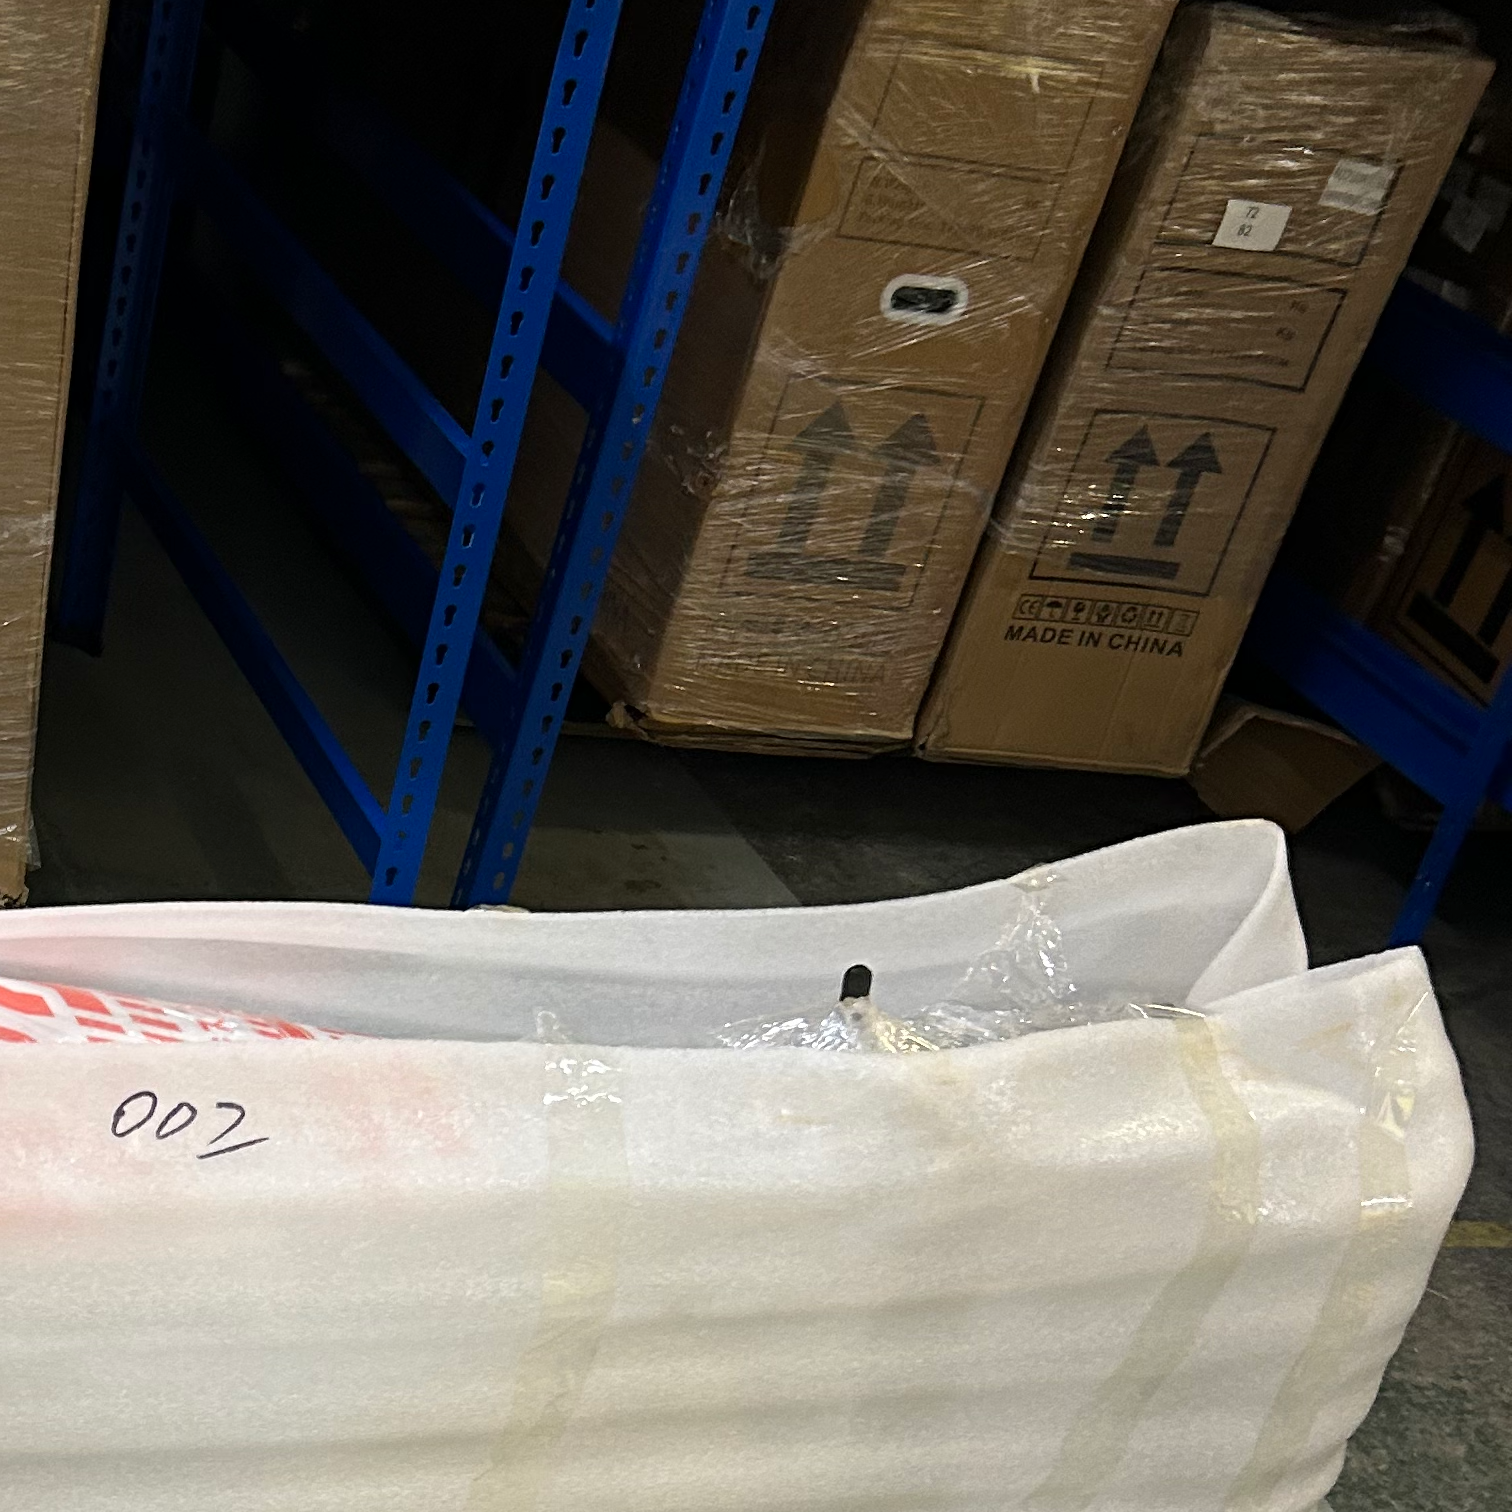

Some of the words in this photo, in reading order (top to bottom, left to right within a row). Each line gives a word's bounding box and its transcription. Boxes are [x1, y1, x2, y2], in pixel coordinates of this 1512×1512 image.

[1245, 206, 1260, 219] 72
[1004, 625, 1074, 645] MADE
[1077, 630, 1102, 648] IN
[1107, 633, 1184, 658] CHINA
[111, 1090, 269, 1159] 002
